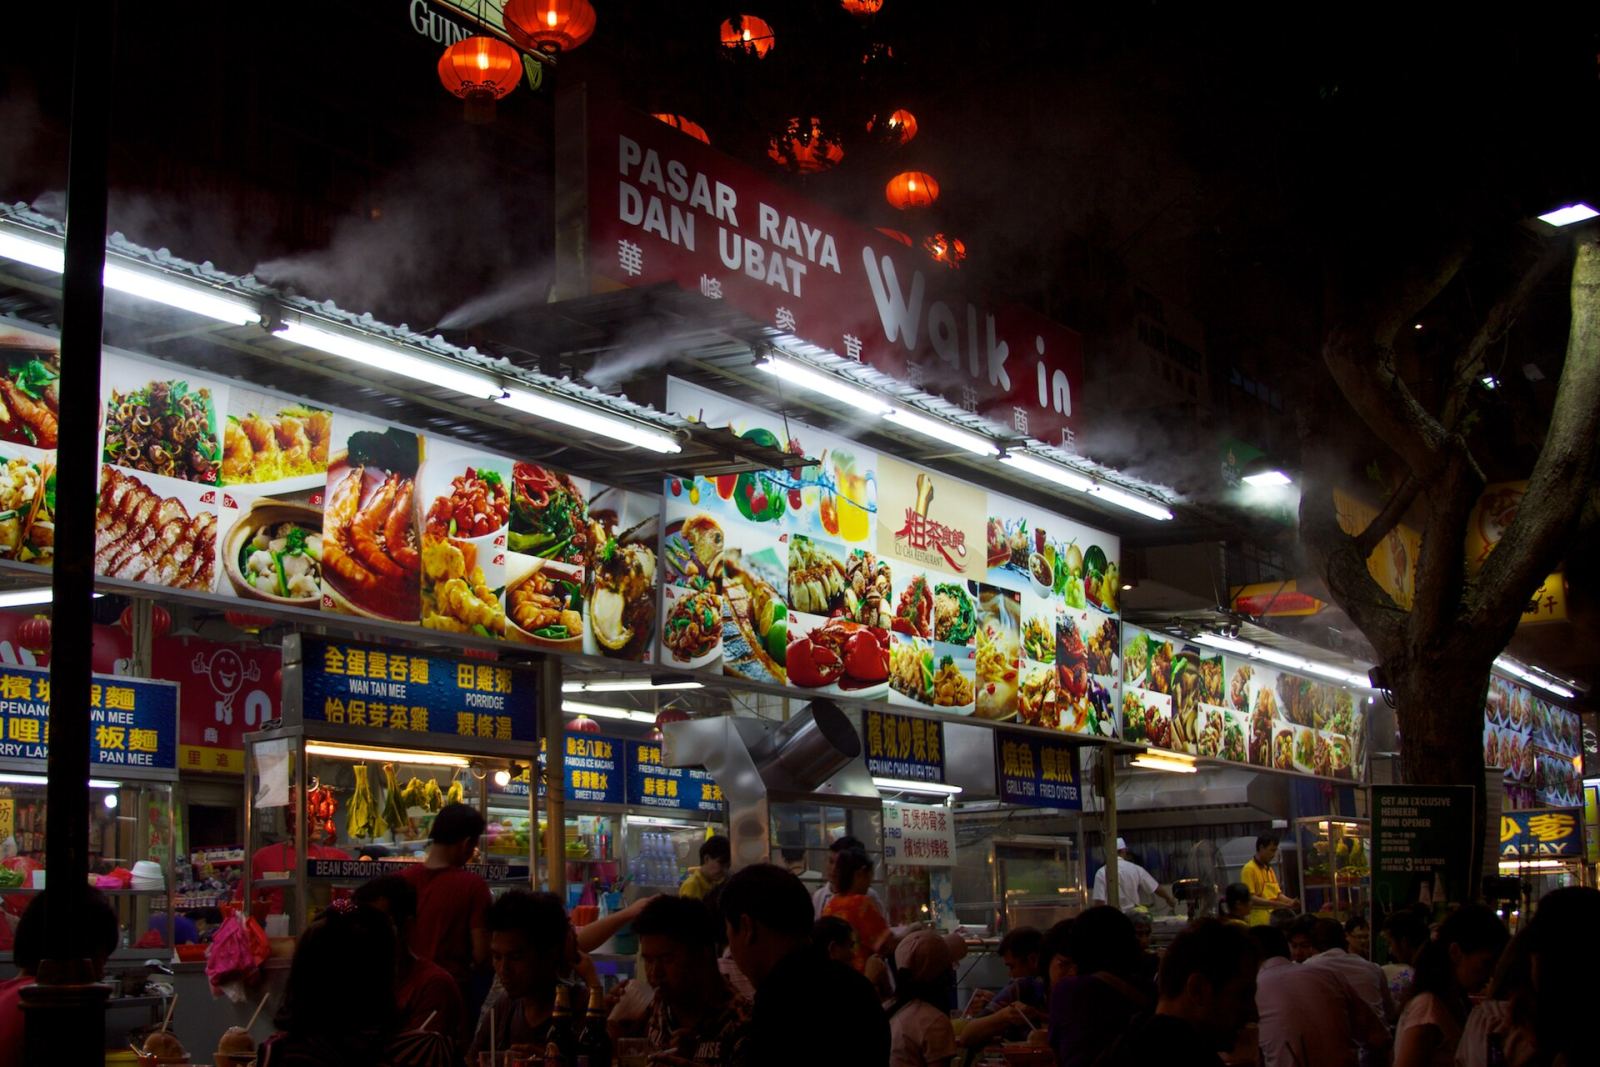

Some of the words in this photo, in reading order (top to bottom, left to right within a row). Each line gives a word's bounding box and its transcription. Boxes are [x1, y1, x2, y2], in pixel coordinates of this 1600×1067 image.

[409, 0, 474, 47] GUIN
[619, 133, 739, 228] PASAR
[759, 202, 841, 274] RAYA
[619, 180, 696, 252] DAN
[718, 226, 808, 298] UBAT
[862, 245, 1011, 392] Walk
[1035, 335, 1072, 418] in
[206, 471, 217, 482] 56
[224, 497, 234, 508] 87
[324, 645, 429, 686] 全蛋雲吞麵
[457, 663, 512, 694] 田雞粥
[349, 678, 370, 696] WAN
[371, 681, 388, 698] TAN
[389, 683, 407, 700] MEE
[465, 692, 505, 711] PORRIDGE
[108, 711, 135, 725] MEE
[324, 696, 429, 733] 怡保芽菜雞
[95, 724, 159, 753] 板麵
[99, 750, 125, 764] PAN
[127, 752, 154, 766] MEE
[564, 756, 585, 768] FAMOUS
[585, 758, 595, 769] ICE
[595, 759, 615, 770] KACANG
[638, 764, 655, 774] FRESH
[655, 765, 668, 776] FRUIT
[668, 767, 683, 778] JUICE
[1006, 779, 1023, 796] GRILL
[1023, 781, 1036, 797] FISH
[1039, 783, 1056, 799] FRIED
[1056, 785, 1078, 801] OYSTER
[641, 795, 658, 806] FRESH
[657, 797, 681, 807] COCONUT
[1381, 796, 1395, 806] GET
[1396, 796, 1409, 806] AN
[1410, 796, 1452, 807] EXCLUSIVE
[1381, 807, 1418, 817] HEINEKEN
[1381, 818, 1400, 828] MINI
[1401, 818, 1432, 828] OPENER
[316, 860, 341, 876] BEAN
[342, 861, 382, 877] SPROUTS
[488, 864, 510, 881] SOUP
[1405, 857, 1414, 872] 3
